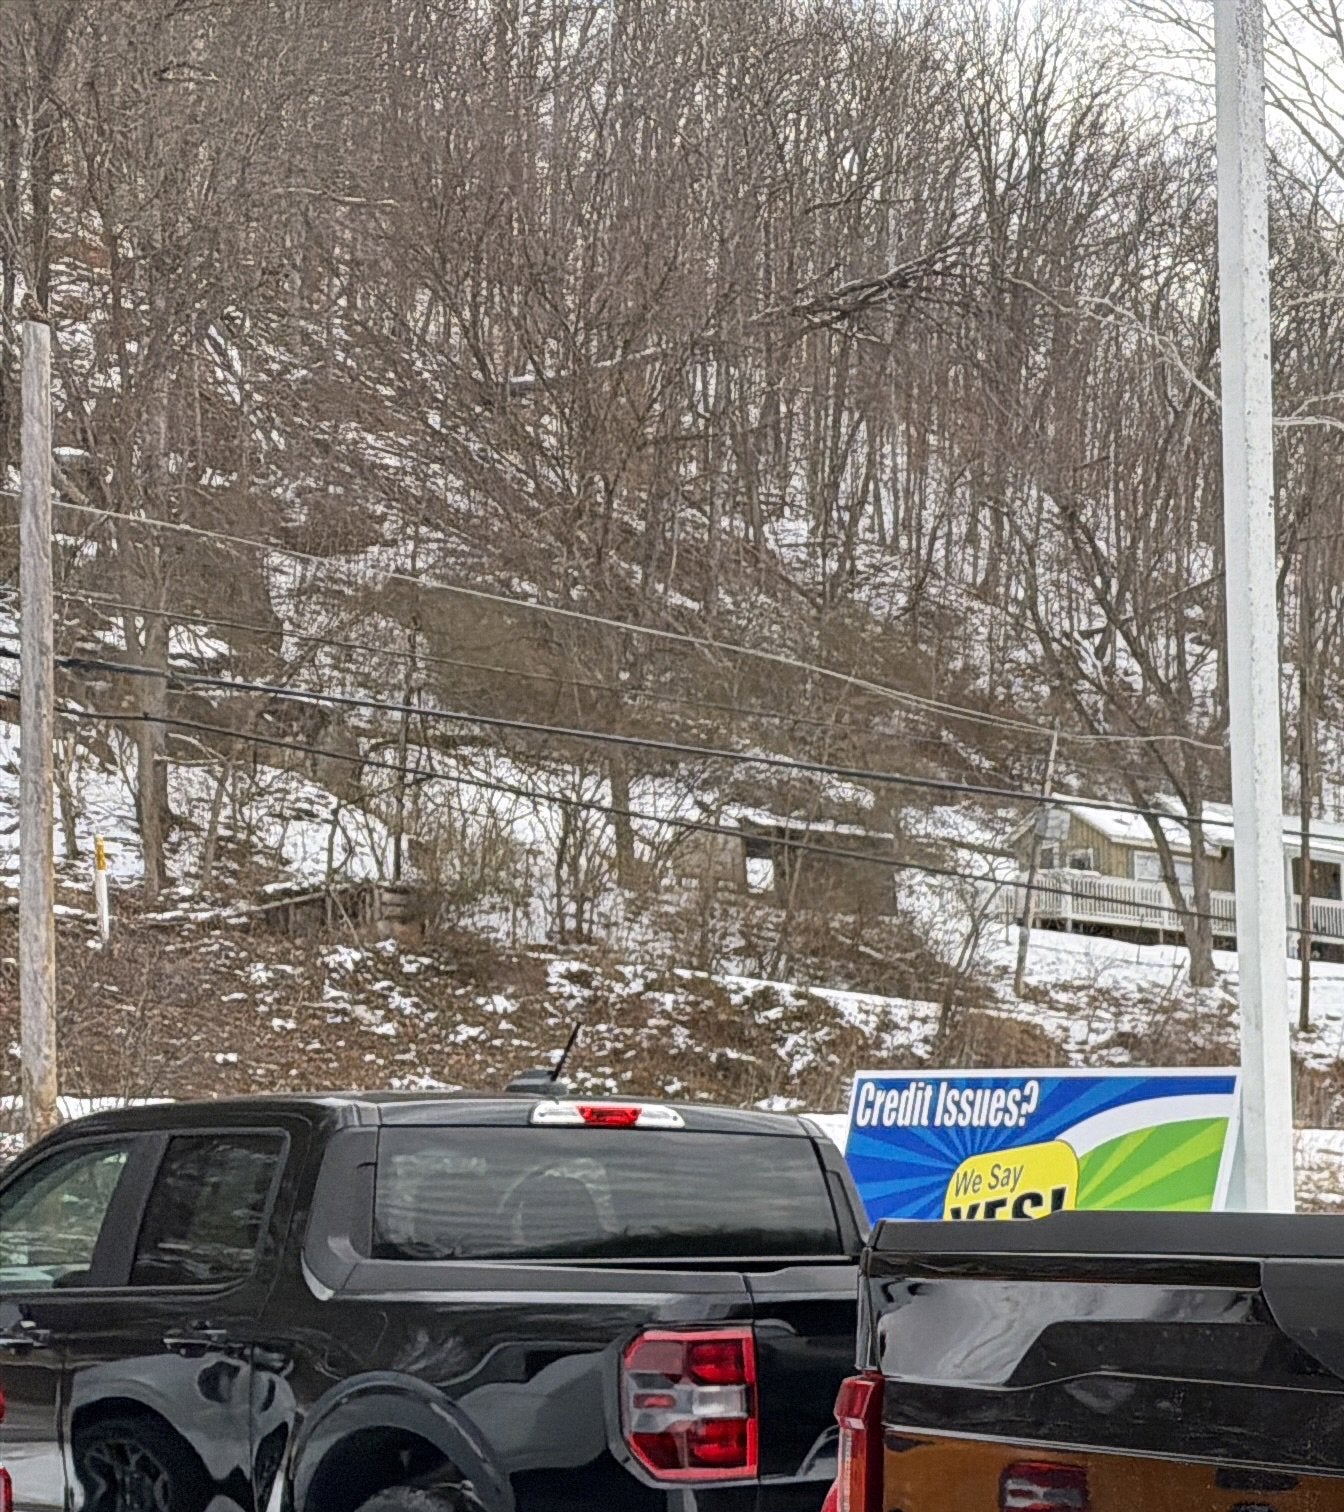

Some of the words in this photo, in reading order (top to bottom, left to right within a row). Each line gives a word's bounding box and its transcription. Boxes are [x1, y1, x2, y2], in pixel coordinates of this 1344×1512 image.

[857, 1082, 932, 1128] Credit
[936, 1080, 1039, 1127] Issues?
[955, 1169, 983, 1197] We
[988, 1164, 1024, 1193] Say
